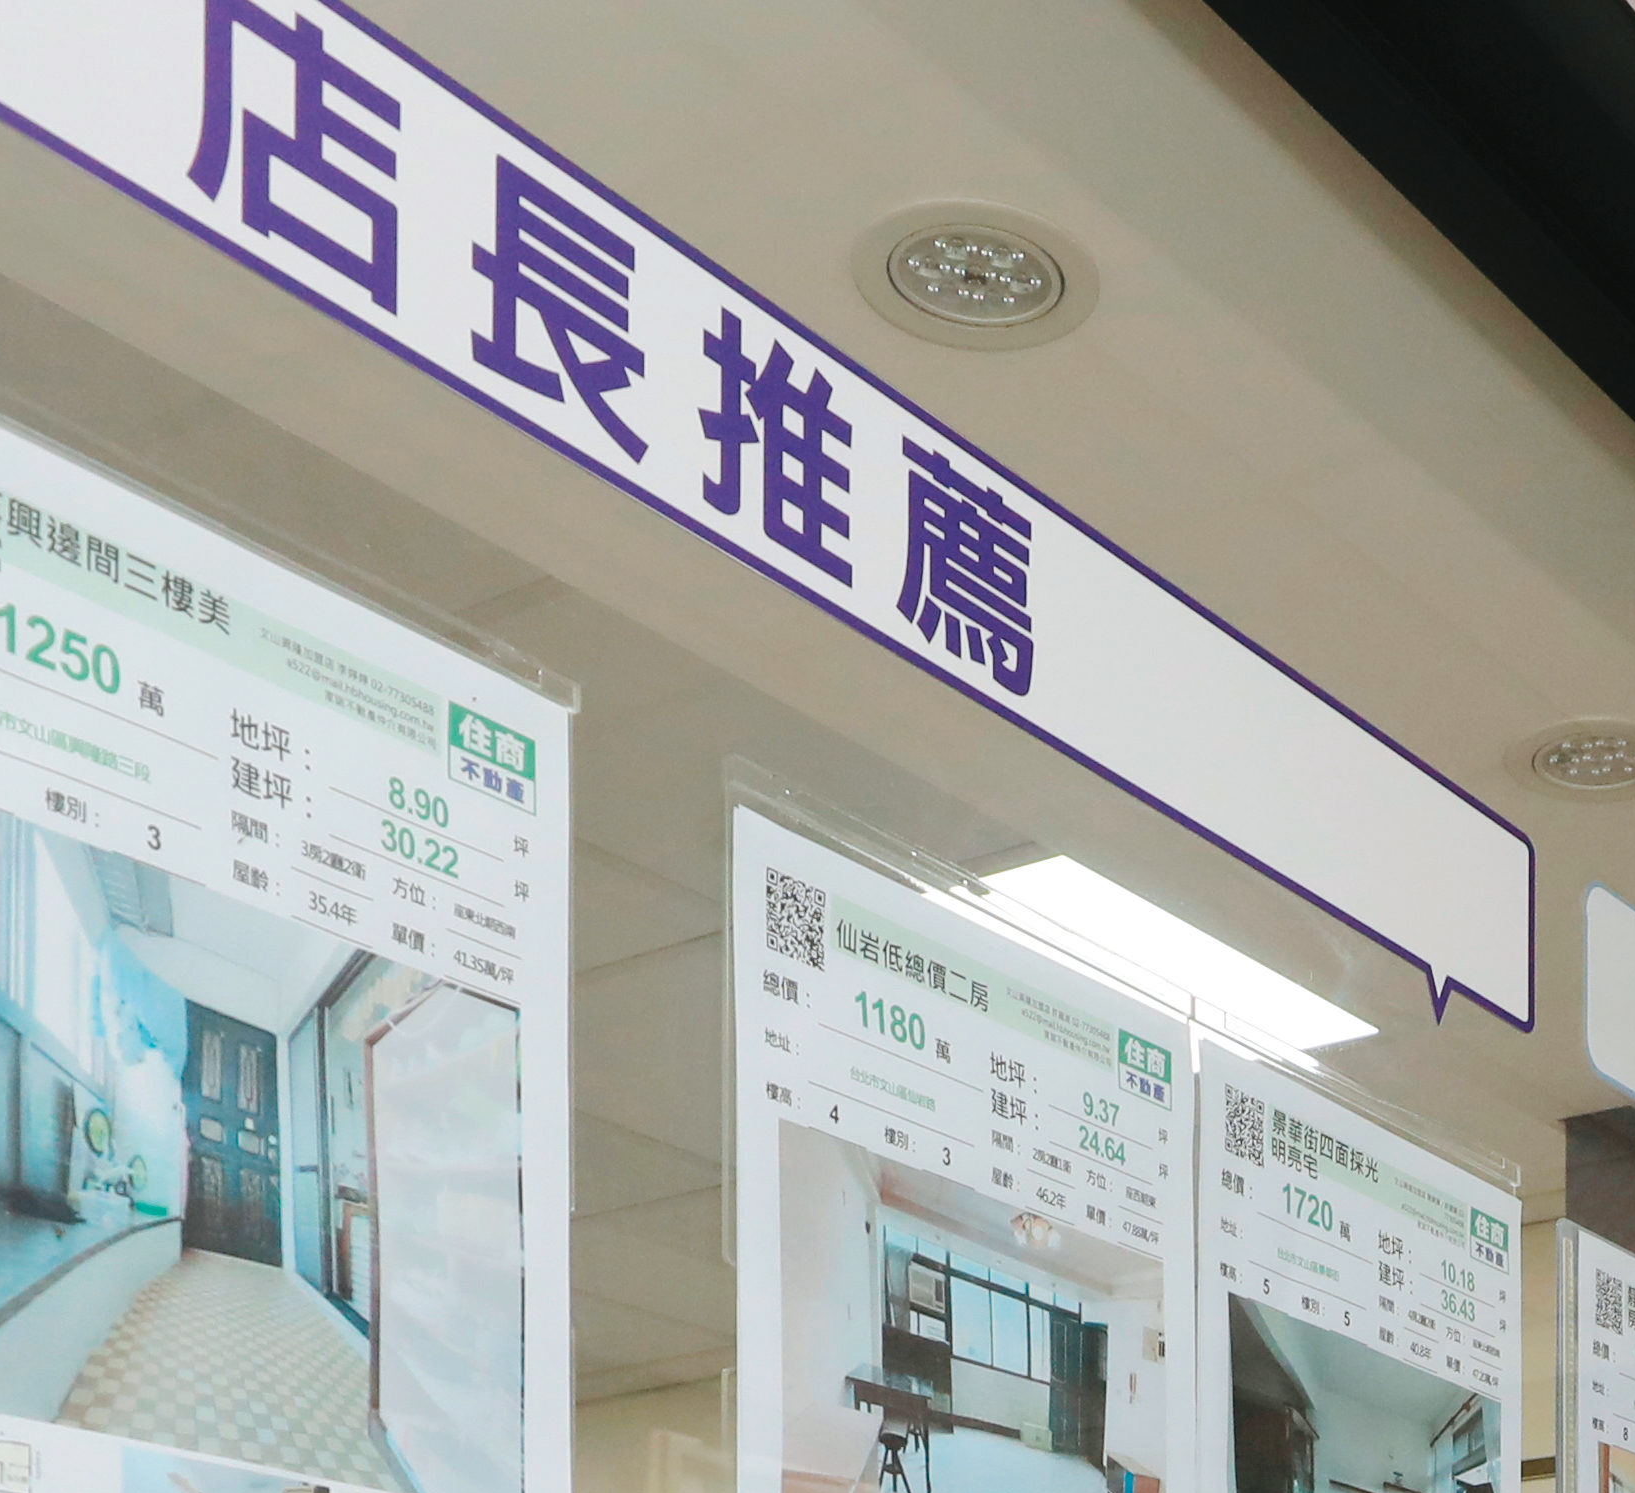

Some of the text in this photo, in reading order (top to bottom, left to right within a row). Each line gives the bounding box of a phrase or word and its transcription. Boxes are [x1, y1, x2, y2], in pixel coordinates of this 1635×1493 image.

[187, 0, 1038, 699] 店長推薦
[137, 681, 166, 717] 萬
[459, 713, 526, 771] 住商
[460, 756, 525, 804] 不動產
[147, 824, 162, 851] 3
[388, 777, 530, 858] 8.90 坪
[380, 818, 530, 902] 30.22 坪
[836, 918, 990, 1013] 仙岩低總價二房
[854, 990, 951, 1066] 1180 萬
[1124, 1038, 1166, 1077] 住商
[1082, 1091, 1120, 1126] 9.37
[1125, 1071, 1165, 1103] 不動產
[829, 1104, 951, 1166] 4 3
[1078, 1125, 1127, 1166] 24.64
[1271, 1136, 1319, 1180] 明亮宅
[1272, 1108, 1380, 1184] 景華街四面採光
[1282, 1183, 1352, 1243] 1720 萬
[1474, 1214, 1506, 1249] 住商
[1441, 1259, 1475, 1293] 10.18
[1474, 1242, 1505, 1269] 不動產
[1263, 1278, 1351, 1327] 5 5
[1441, 1289, 1476, 1322] 36.43
